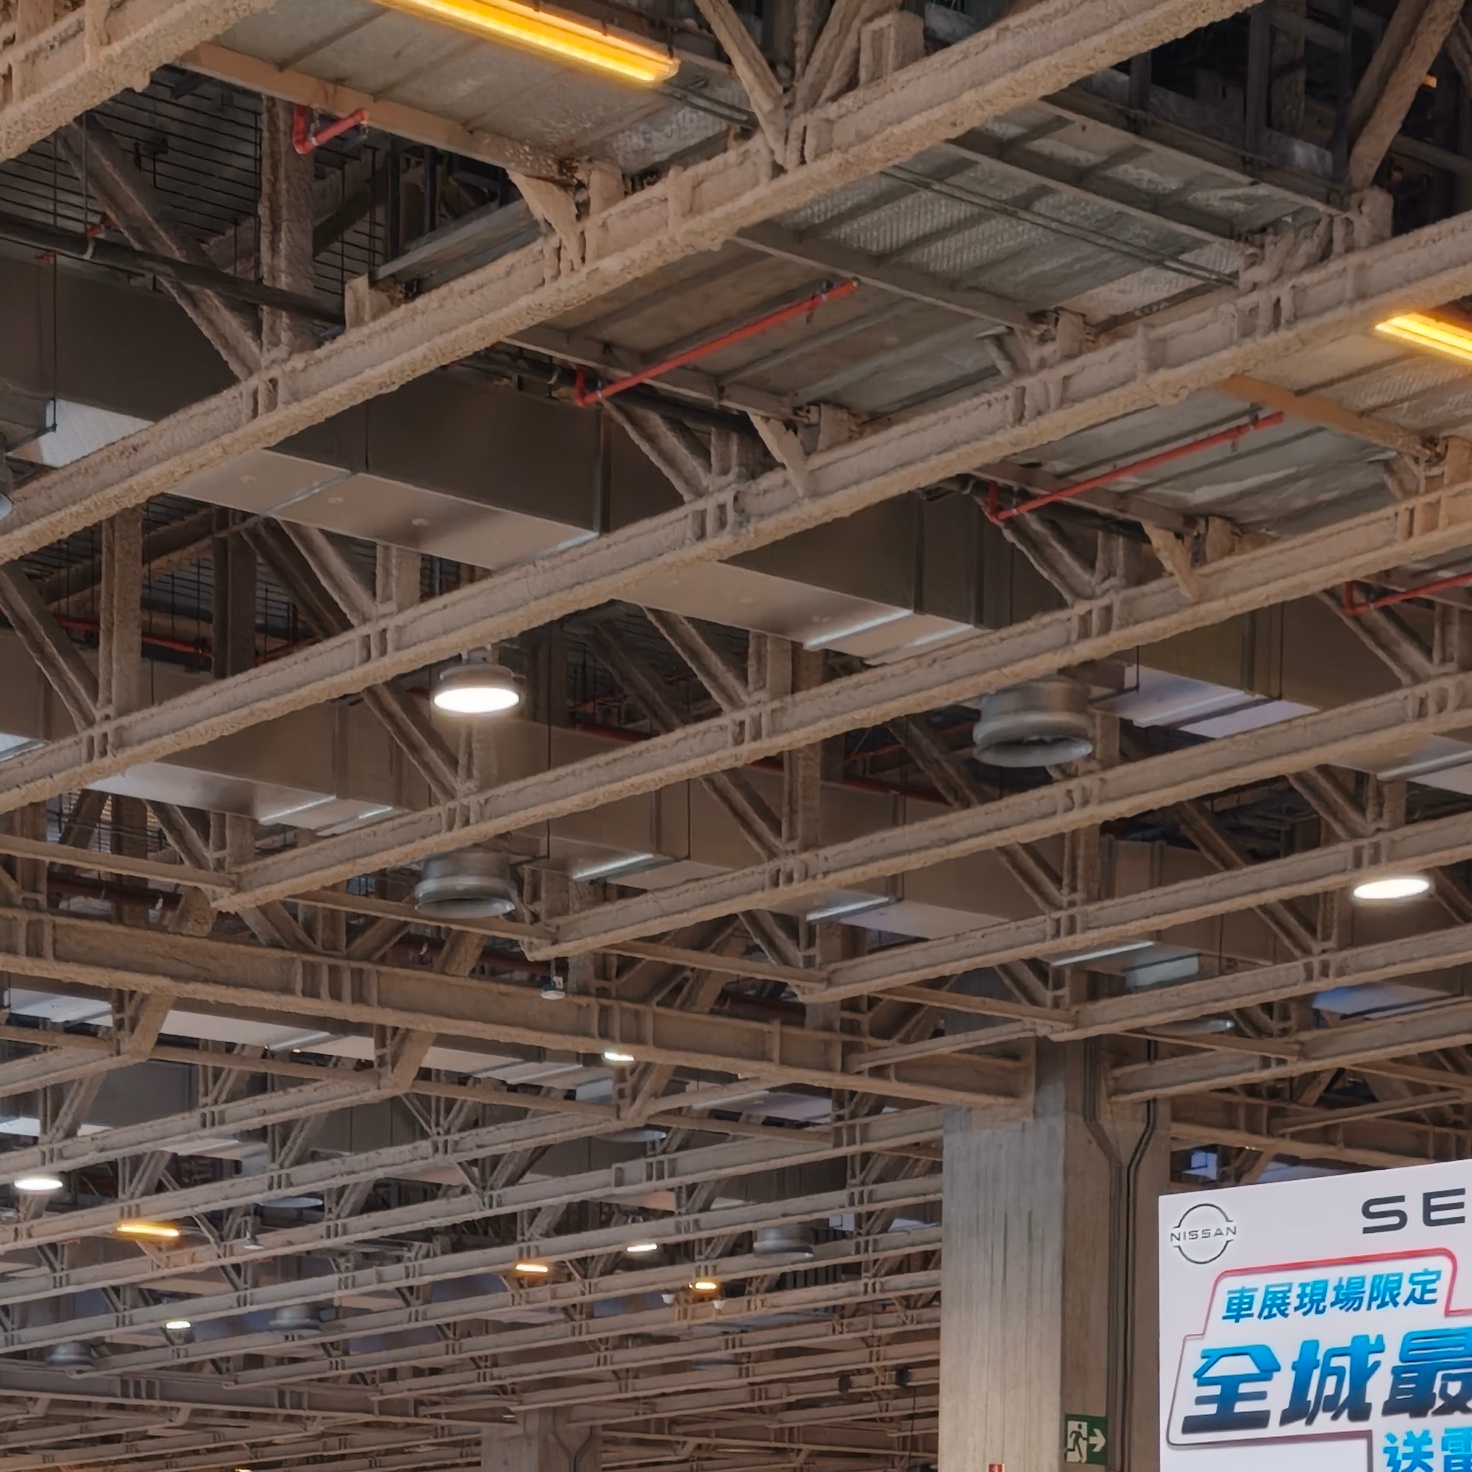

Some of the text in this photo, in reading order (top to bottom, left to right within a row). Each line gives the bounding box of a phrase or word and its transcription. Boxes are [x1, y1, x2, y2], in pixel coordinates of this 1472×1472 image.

[1170, 1226, 1236, 1241] NISSAN
[1221, 1269, 1440, 1324] 車展現場限定
